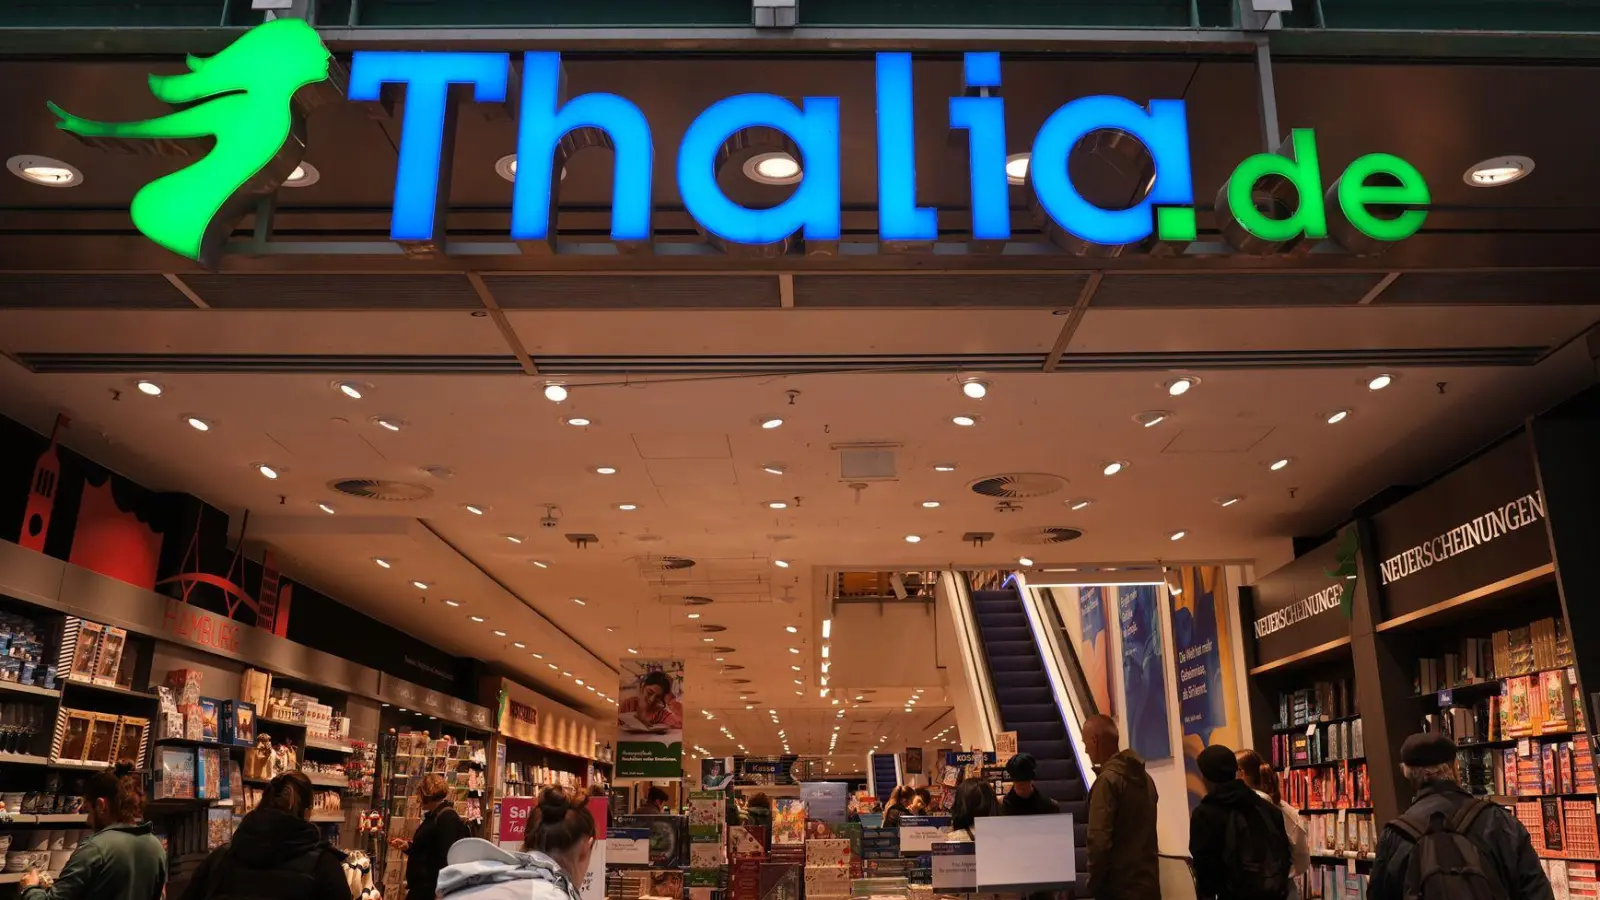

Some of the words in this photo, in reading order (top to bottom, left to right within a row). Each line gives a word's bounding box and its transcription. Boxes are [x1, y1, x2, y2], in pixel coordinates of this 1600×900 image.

[347, 51, 1432, 246] Thalia.de
[1379, 489, 1546, 586] NEUERSCHEINUNGEN
[162, 599, 240, 655] HAMBURG
[752, 764, 776, 773] Kasse
[956, 753, 989, 763] KOSS
[509, 806, 531, 819] Sal
